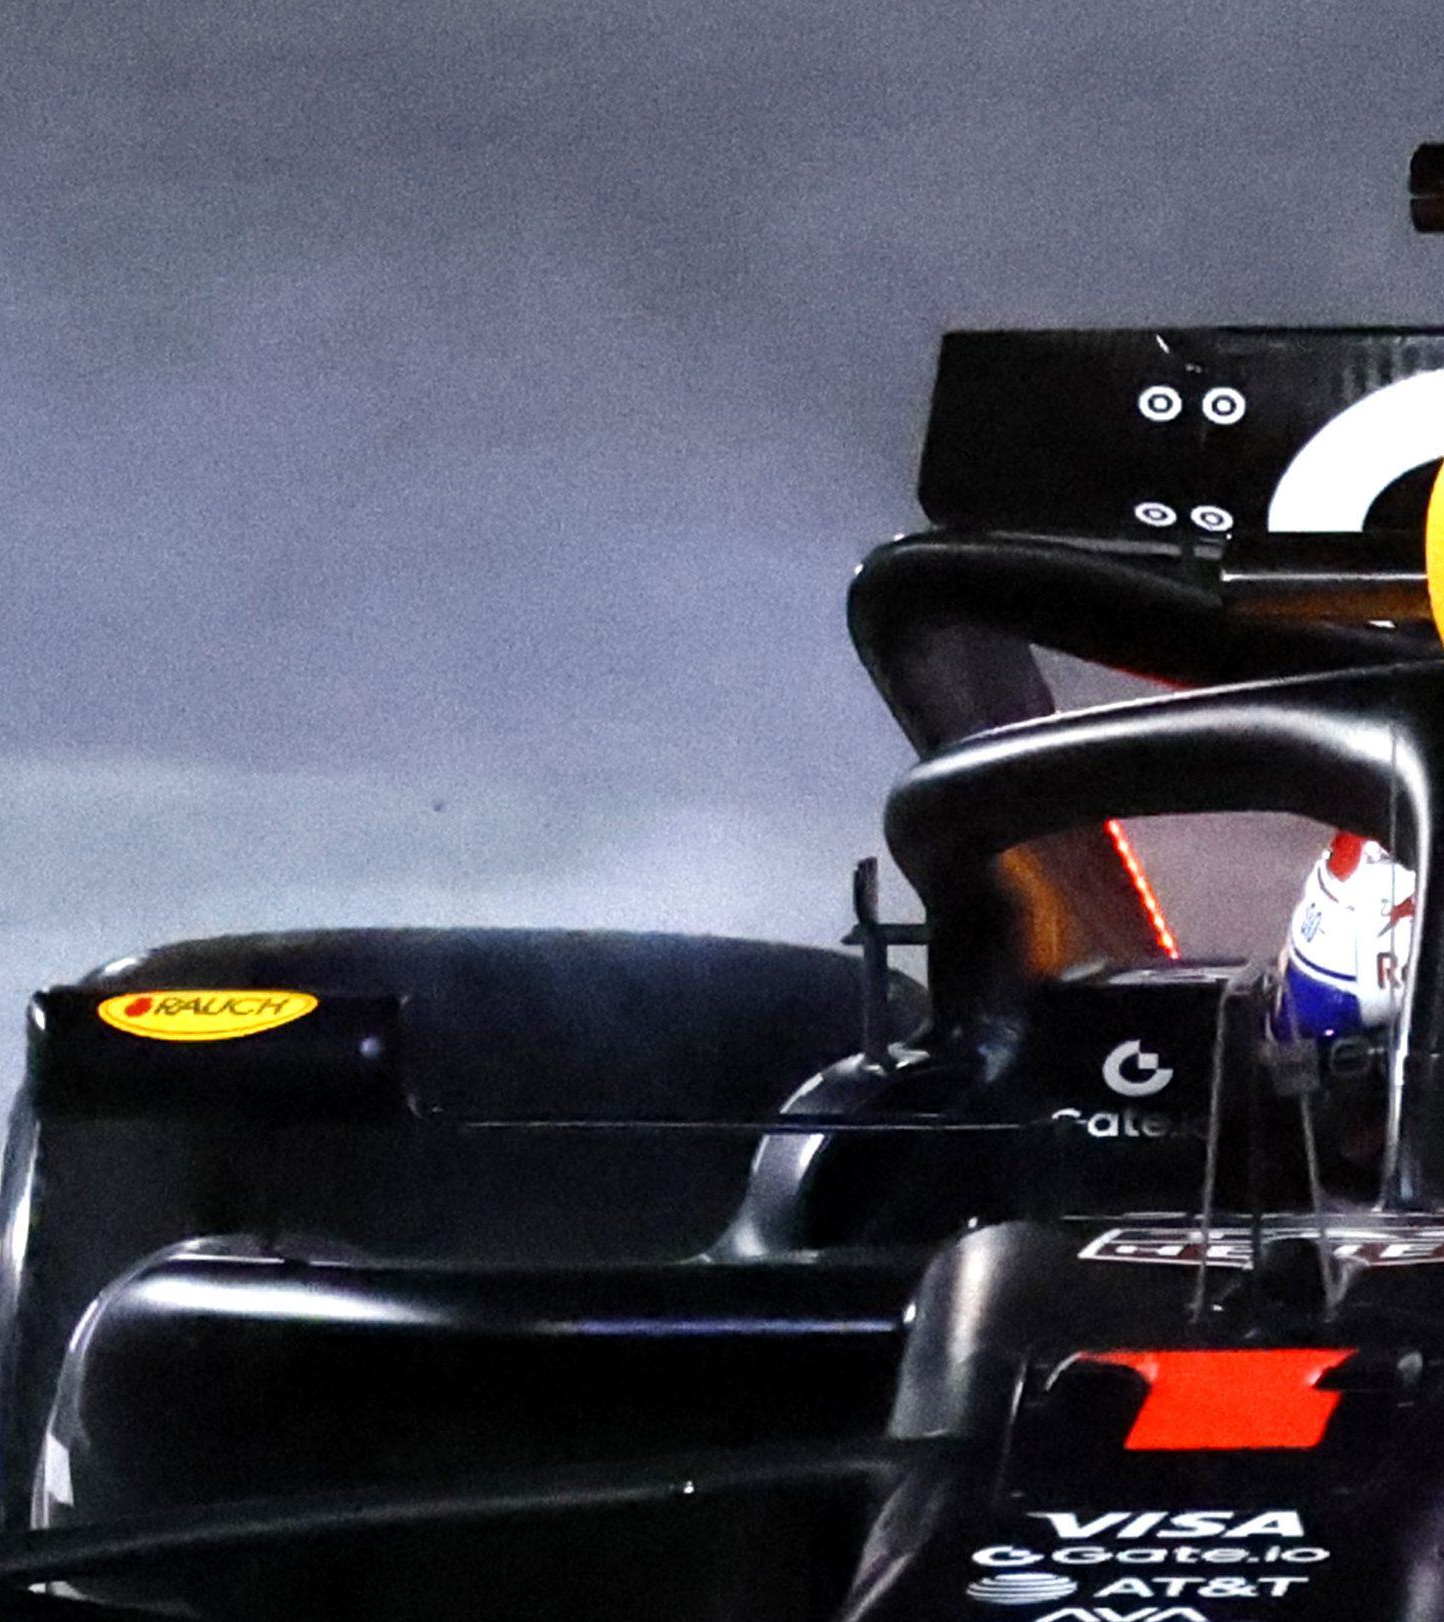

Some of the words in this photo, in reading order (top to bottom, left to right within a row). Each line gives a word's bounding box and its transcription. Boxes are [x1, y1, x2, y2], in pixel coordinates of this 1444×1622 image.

[154, 997, 290, 1017] RAUCH
[1076, 1349, 1356, 1450] 1
[1025, 1510, 1305, 1539] VISA
[1051, 1545, 1331, 1565] Gate.io
[1092, 1576, 1310, 1599] AT&T
